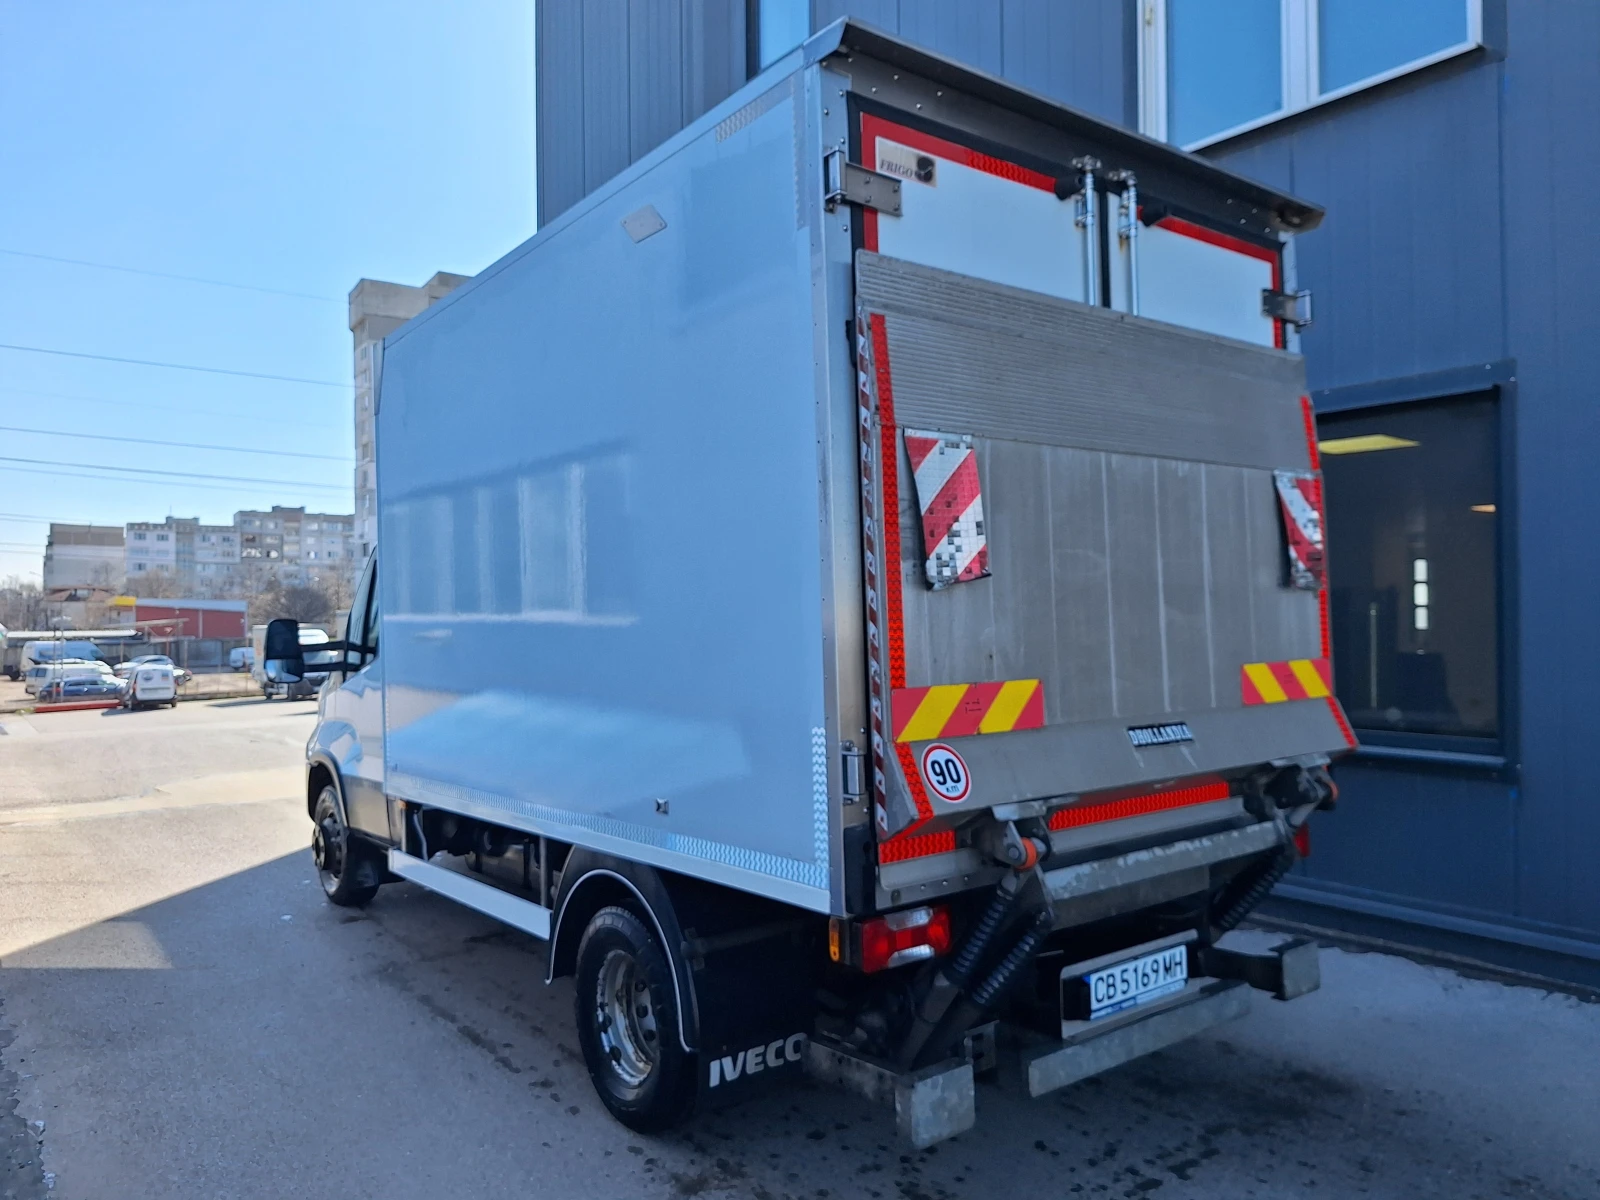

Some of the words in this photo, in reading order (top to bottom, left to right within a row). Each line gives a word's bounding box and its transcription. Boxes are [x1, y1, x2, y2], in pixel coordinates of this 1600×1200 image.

[880, 158, 913, 178] FRIGO
[930, 758, 961, 786] 90
[709, 1032, 808, 1088] IVECO
